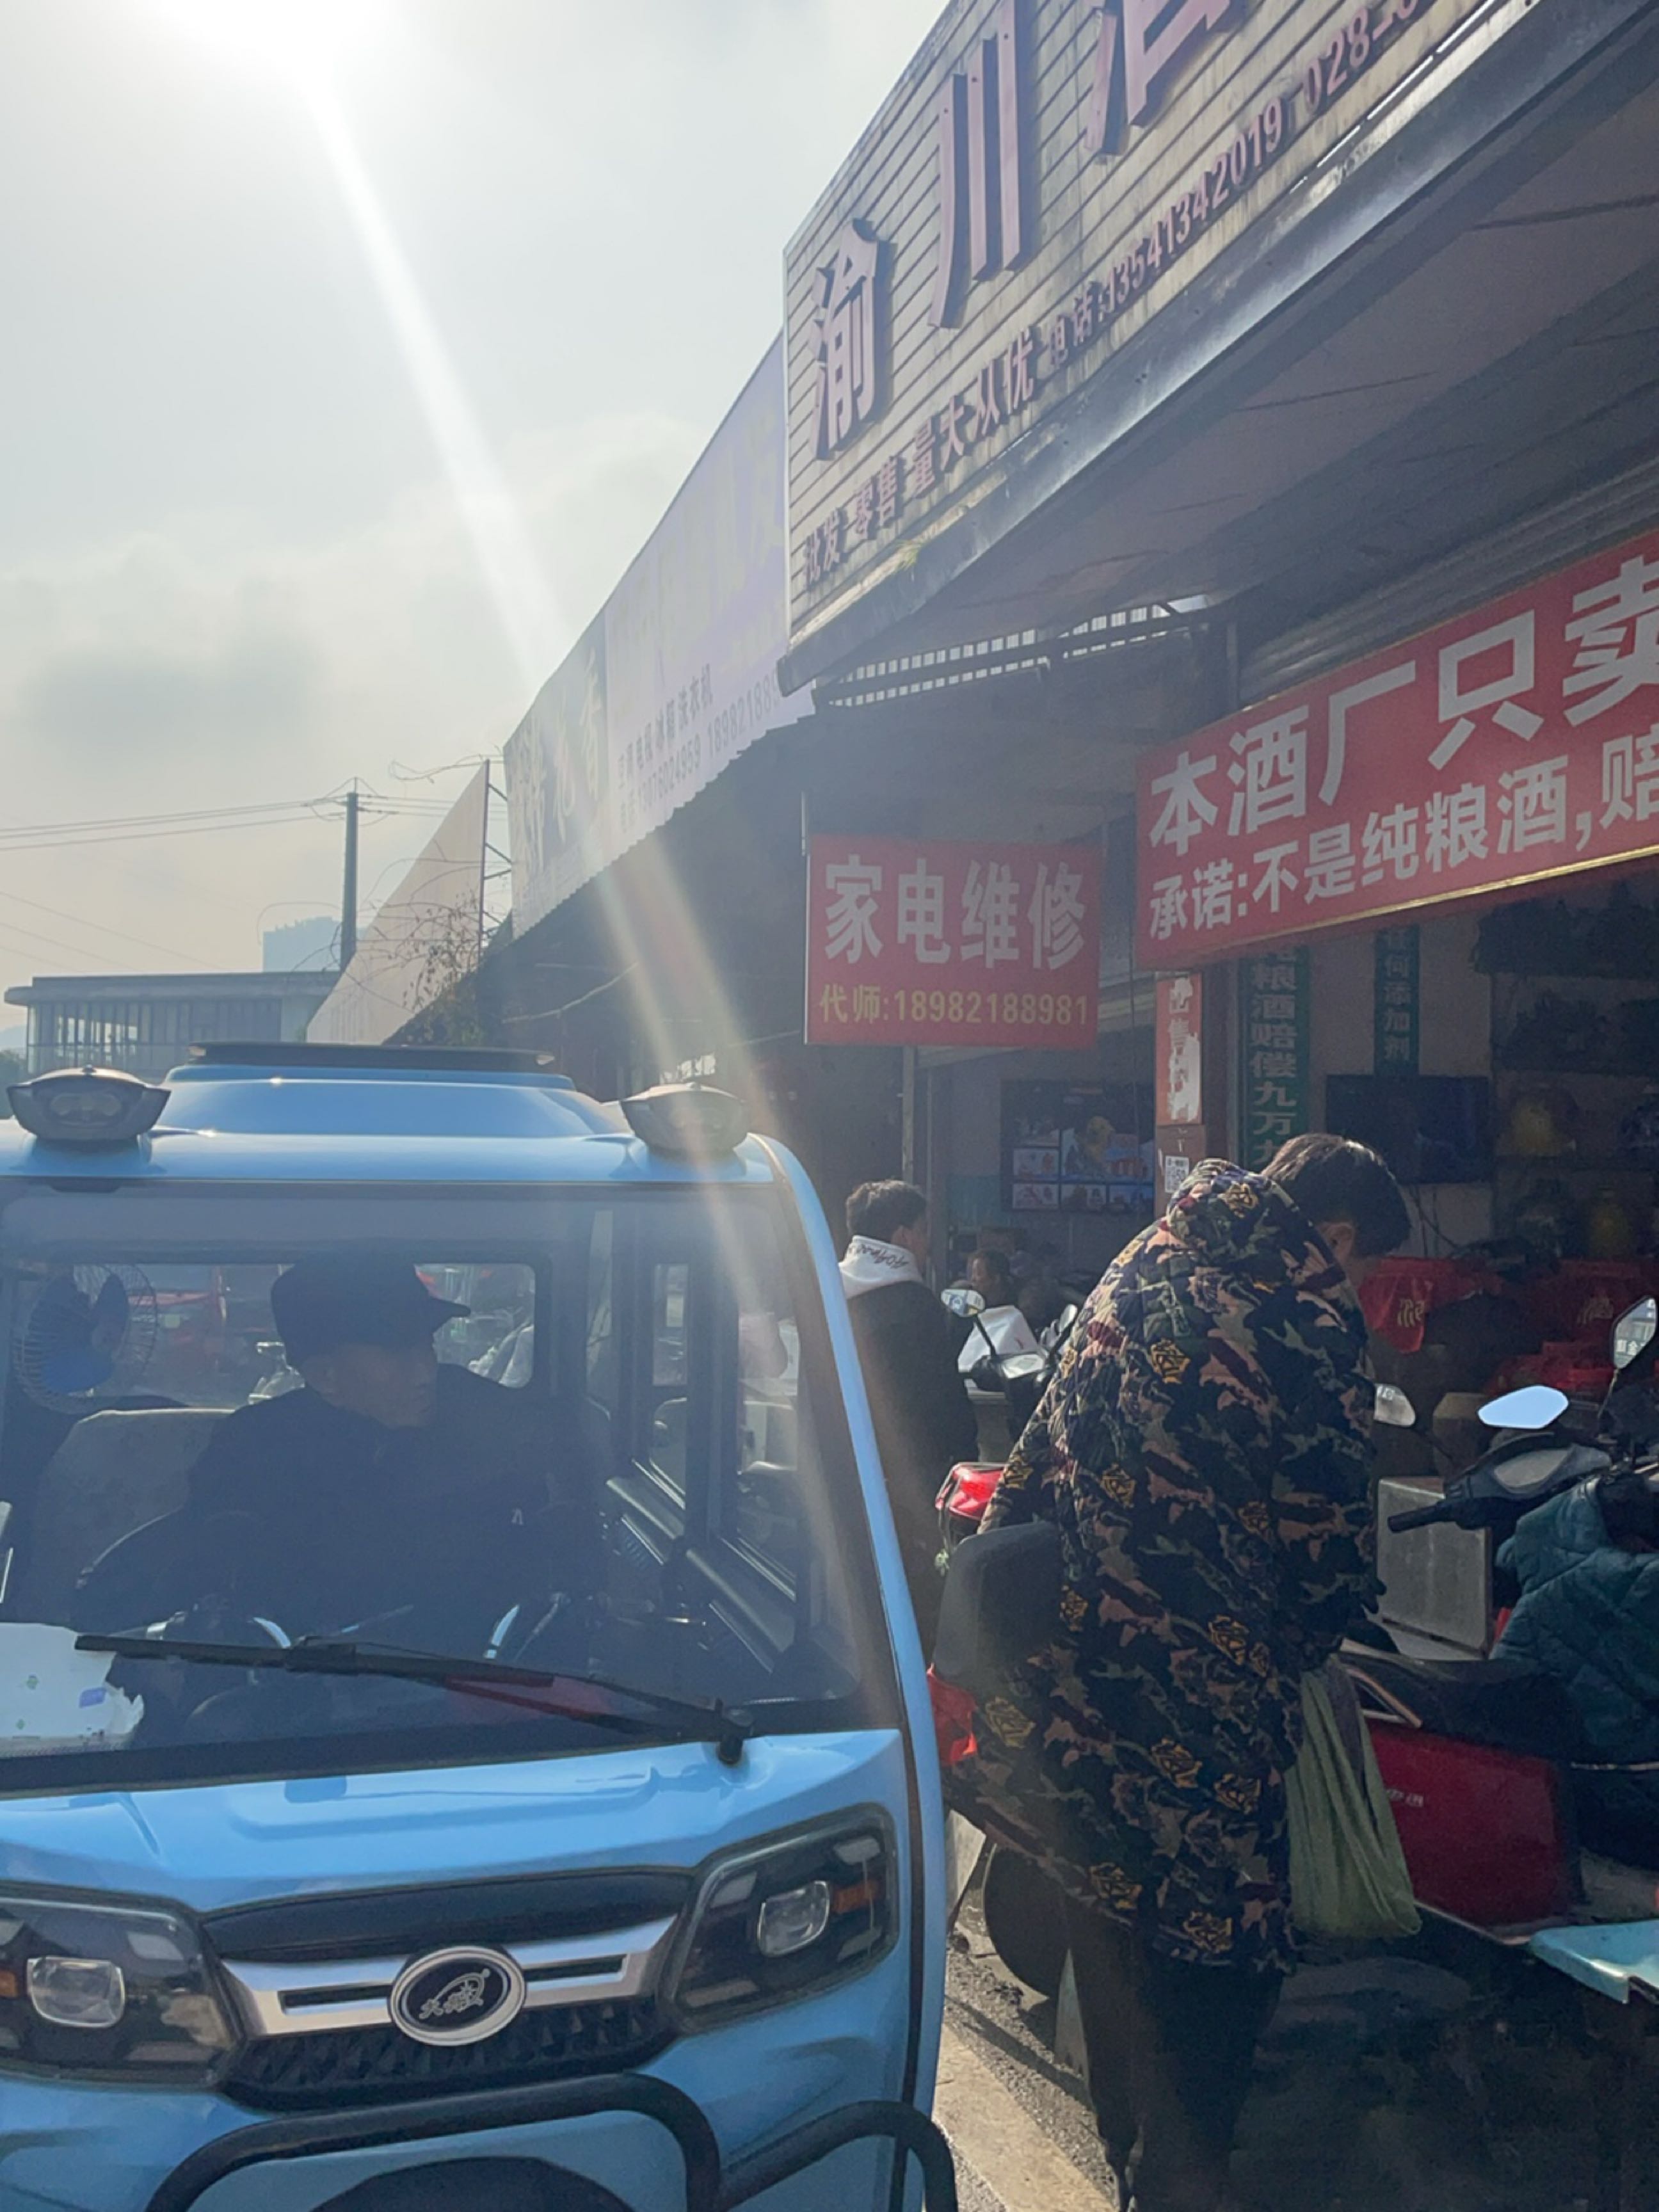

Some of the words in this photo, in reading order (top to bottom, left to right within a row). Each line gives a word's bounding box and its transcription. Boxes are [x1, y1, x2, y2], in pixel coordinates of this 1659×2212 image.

[913, 327, 1034, 498] 量大从优
[1149, 554, 1659, 856] 本酒厂只卖
[824, 854, 1086, 970] 家电维修
[819, 983, 1087, 1025] 代师:18982188981
